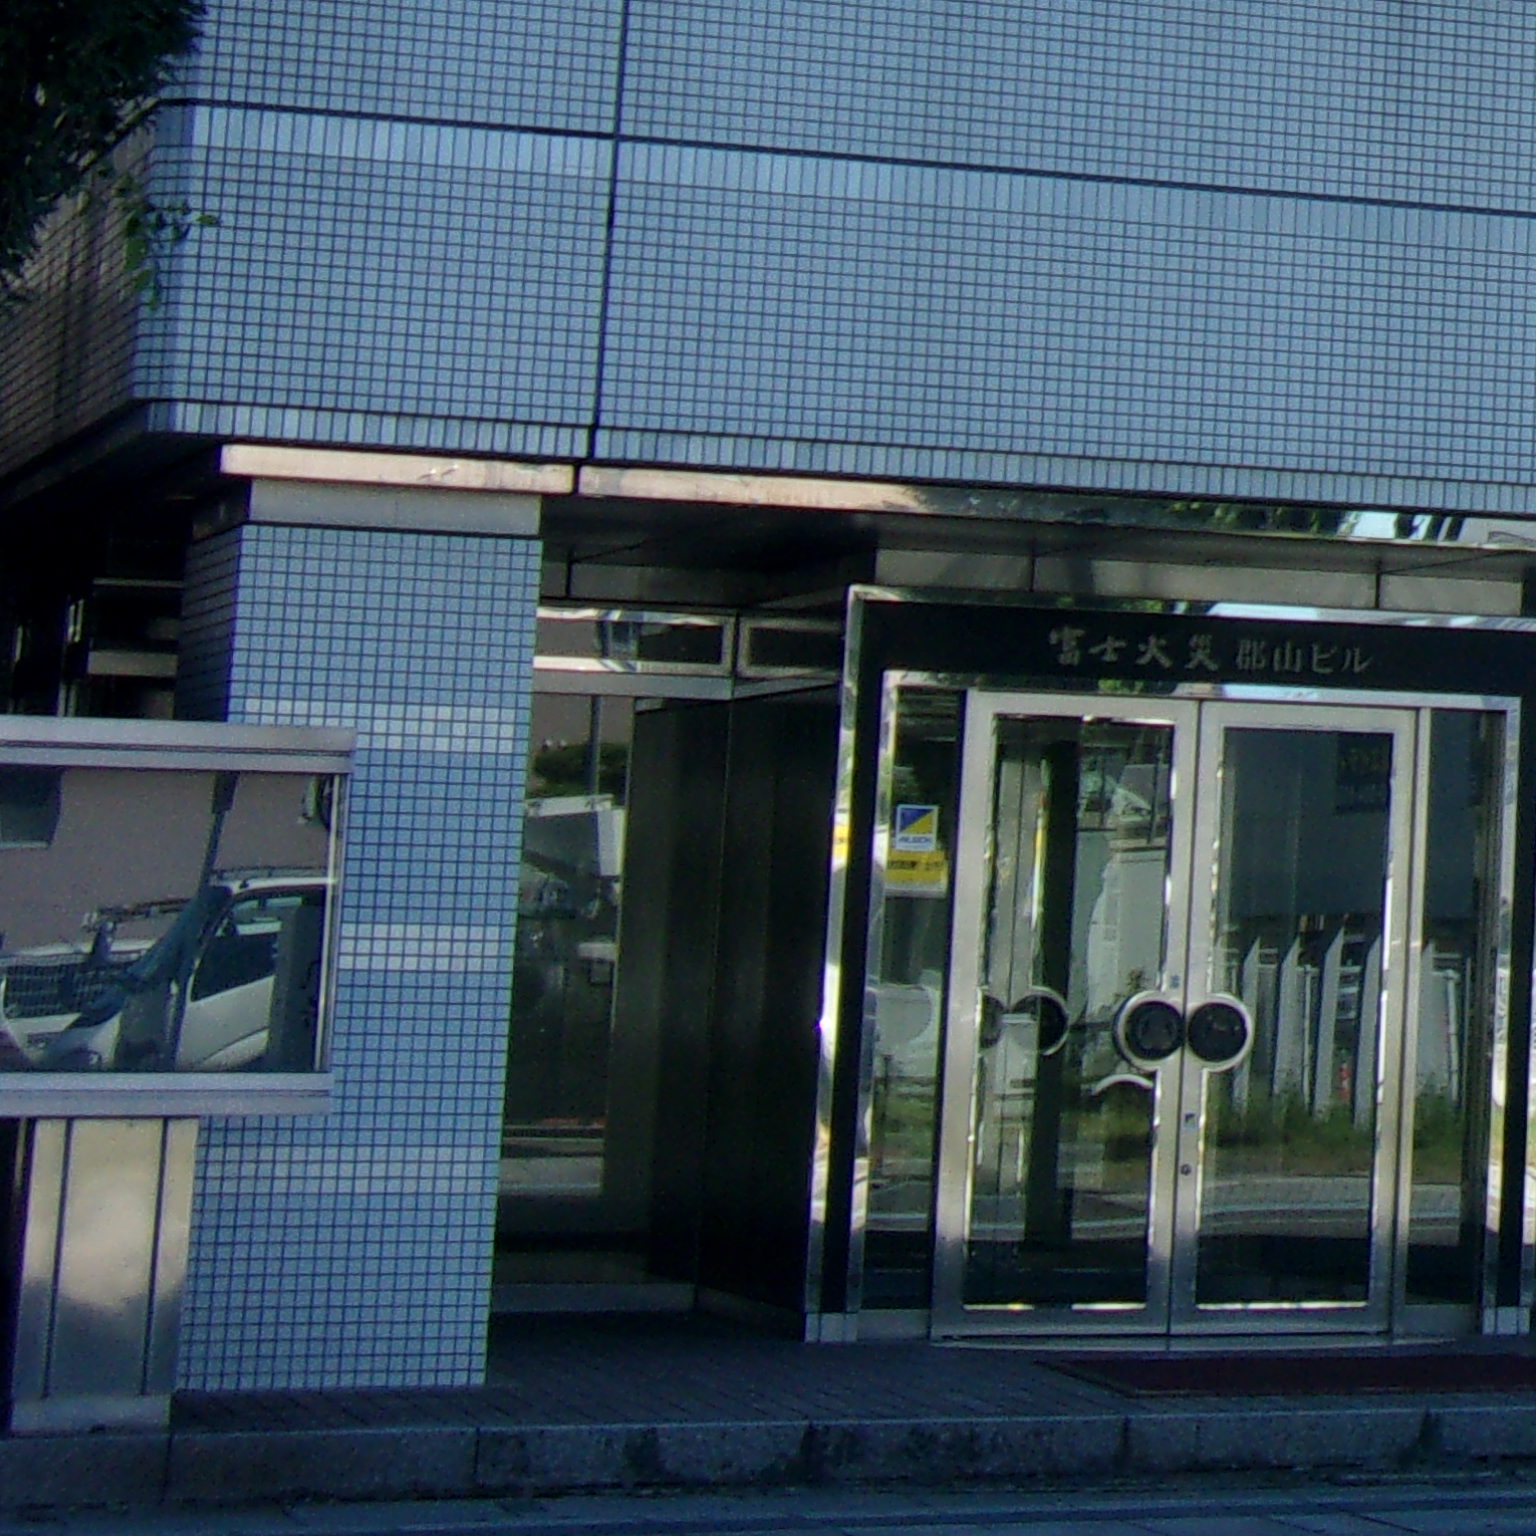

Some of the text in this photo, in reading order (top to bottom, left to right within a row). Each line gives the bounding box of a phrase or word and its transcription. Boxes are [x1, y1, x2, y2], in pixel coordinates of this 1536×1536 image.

[1050, 625, 1373, 674] 富士火災 郡山ビル
